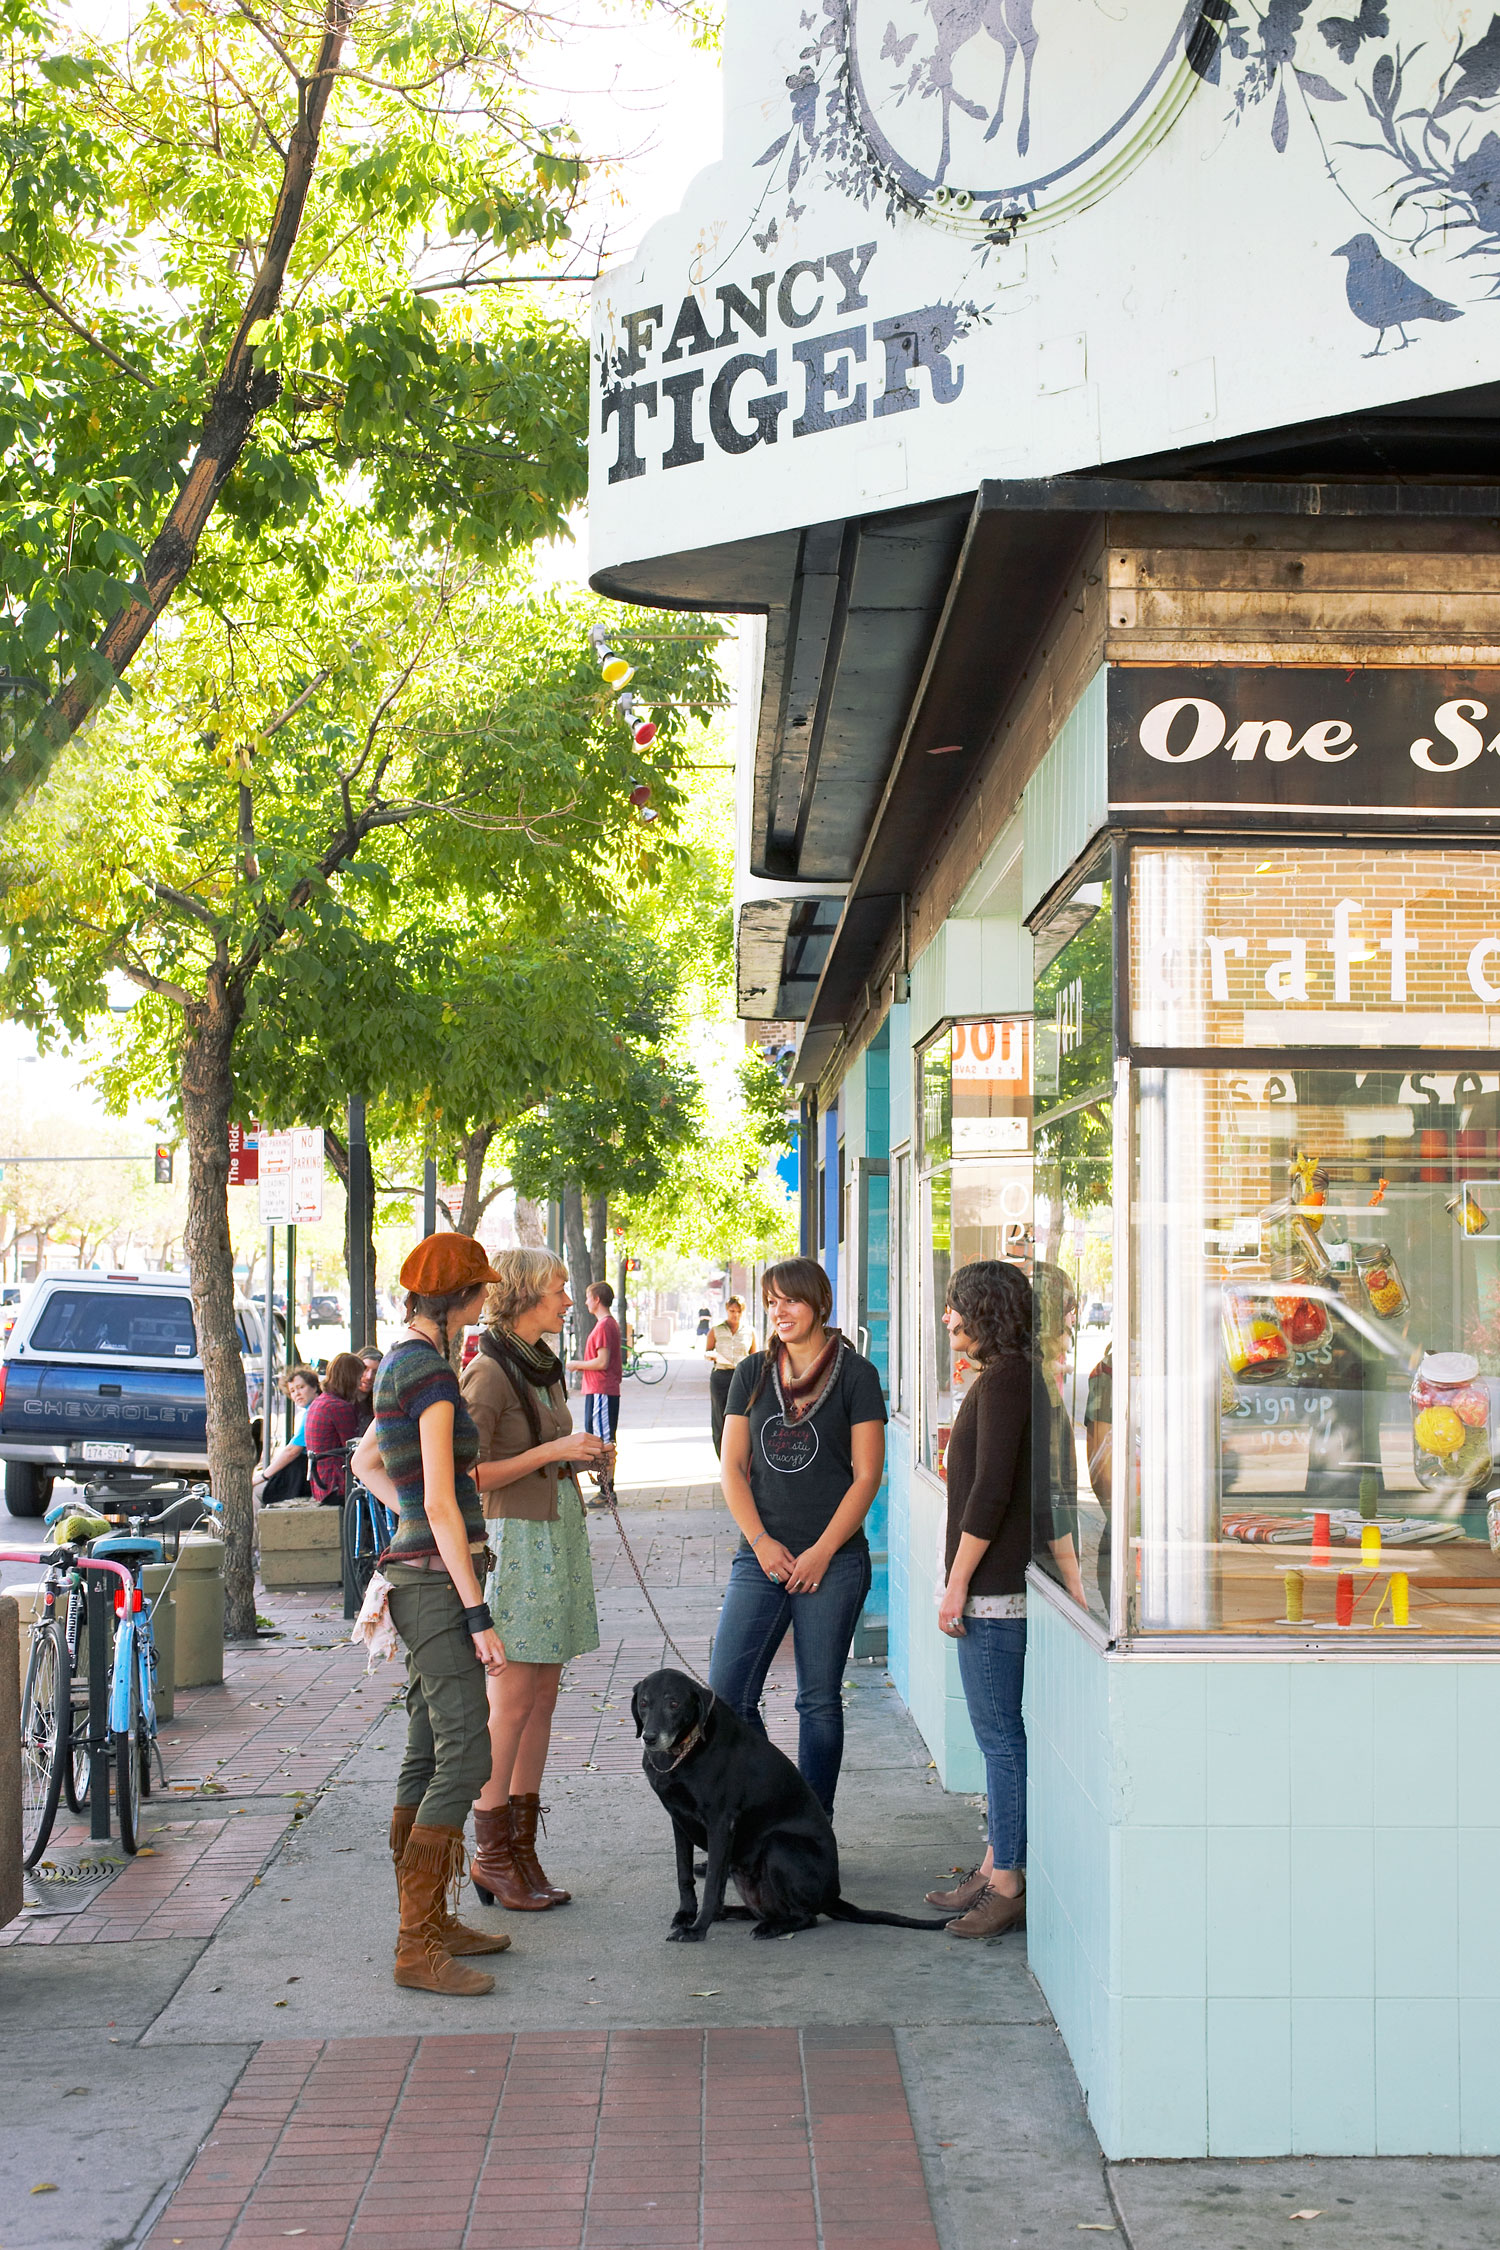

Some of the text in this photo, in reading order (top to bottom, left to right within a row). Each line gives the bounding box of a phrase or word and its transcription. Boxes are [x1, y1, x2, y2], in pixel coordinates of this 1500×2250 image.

[619, 241, 878, 380] FANCY
[601, 305, 965, 486] TIGER
[1139, 697, 1500, 773] One S
[301, 1135, 314, 1149] NO
[228, 1158, 239, 1184] The
[293, 1155, 321, 1169] PARKING
[264, 1179, 286, 1188] LOADING
[301, 1176, 313, 1185] ANY
[300, 1191, 313, 1201] TIME
[23, 1399, 194, 1423] CHEVROLET
[1236, 1392, 1333, 1425] sign up
[1261, 1419, 1332, 1454] now!
[67, 1595, 78, 1644] HANDMADE
